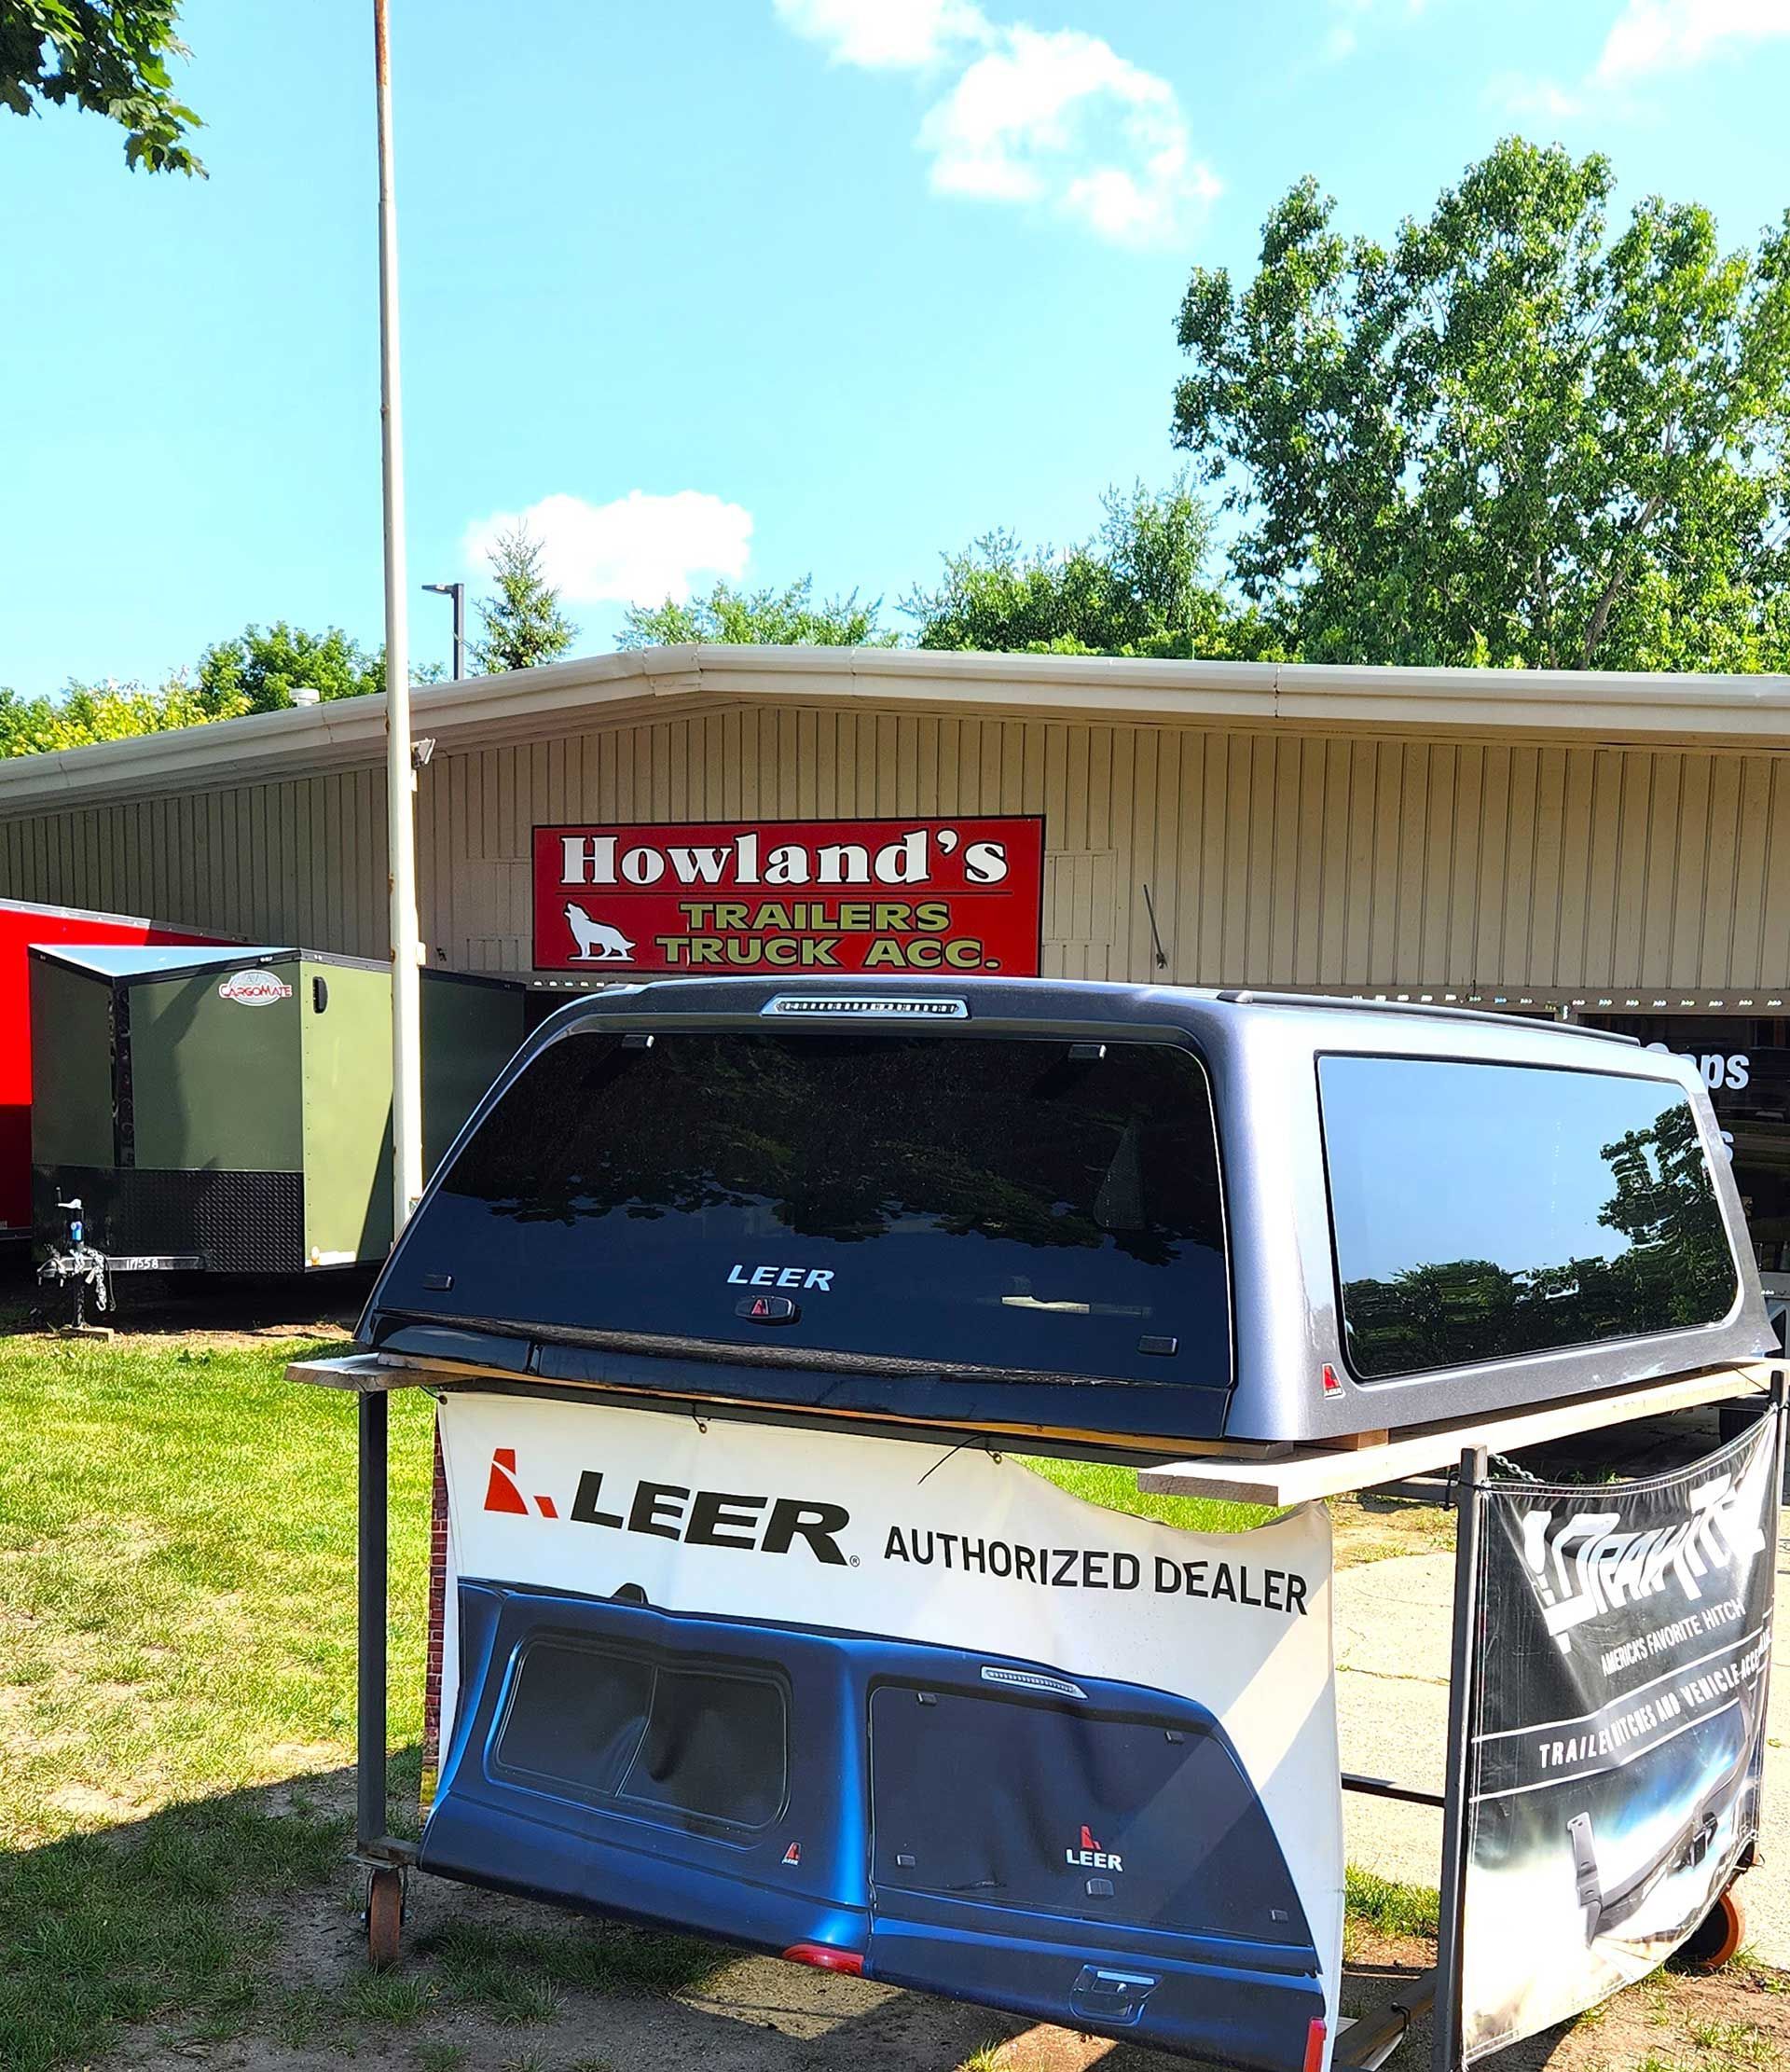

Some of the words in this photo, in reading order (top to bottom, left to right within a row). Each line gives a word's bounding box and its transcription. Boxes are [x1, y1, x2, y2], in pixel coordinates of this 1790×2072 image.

[560, 829, 1009, 886] Howland's
[679, 901, 951, 932] TRAILERS
[655, 935, 840, 966] TRUCK
[864, 937, 1000, 969] ACC.
[727, 1264, 834, 1292] LEER
[883, 1525, 1140, 1590] AUTHORIZED
[1155, 1558, 1308, 1616] DEALER
[1601, 1637, 1648, 1678] AMERICA'S
[1647, 1614, 1704, 1656] FAVORITE
[1701, 1597, 1747, 1632] HITCH
[1655, 1692, 1682, 1723] AND
[1680, 1662, 1742, 1708] VEHICLE
[1066, 1848, 1123, 1872] LEER
